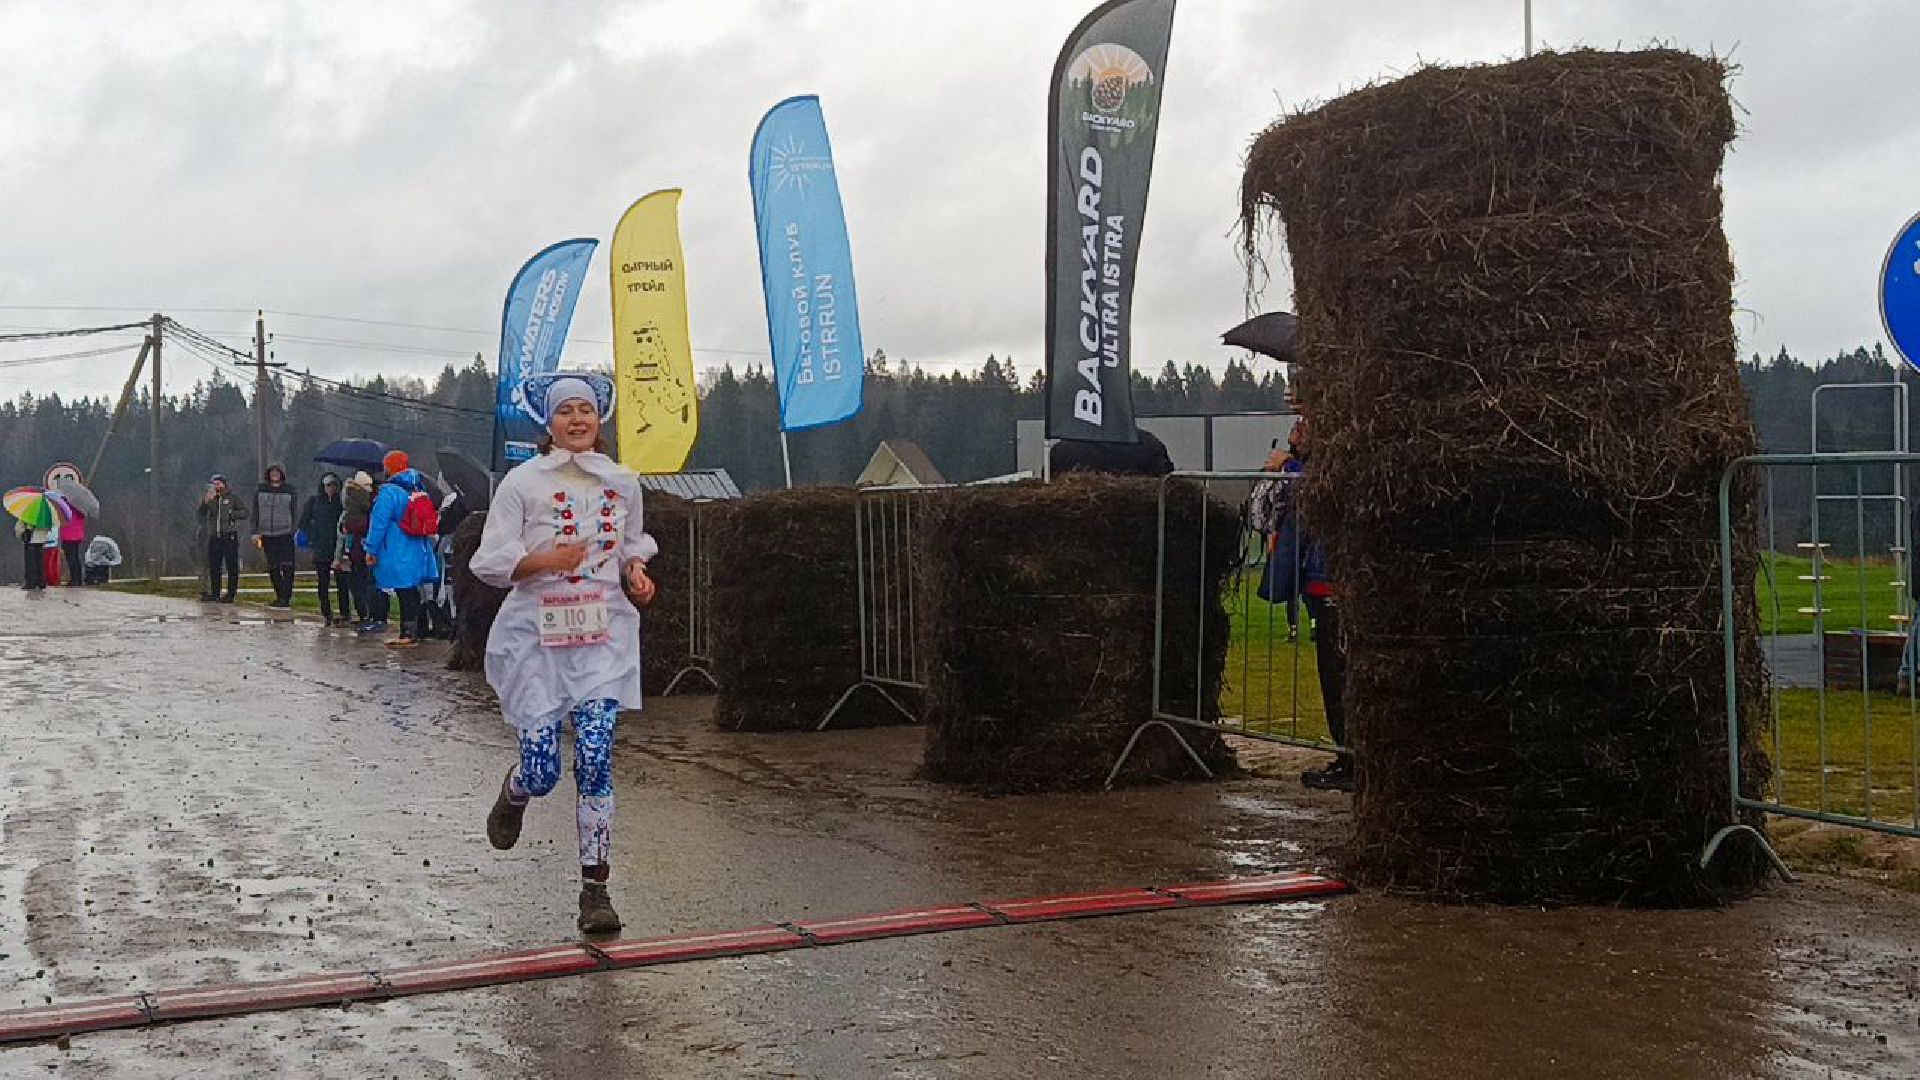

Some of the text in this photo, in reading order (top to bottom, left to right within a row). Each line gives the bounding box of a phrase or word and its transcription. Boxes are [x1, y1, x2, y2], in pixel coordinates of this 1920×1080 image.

[816, 273, 842, 382] ISTRRUN
[1074, 146, 1103, 427] BACKYARD
[1101, 215, 1124, 368] ULTRA ISTRA
[564, 608, 587, 628] 110
